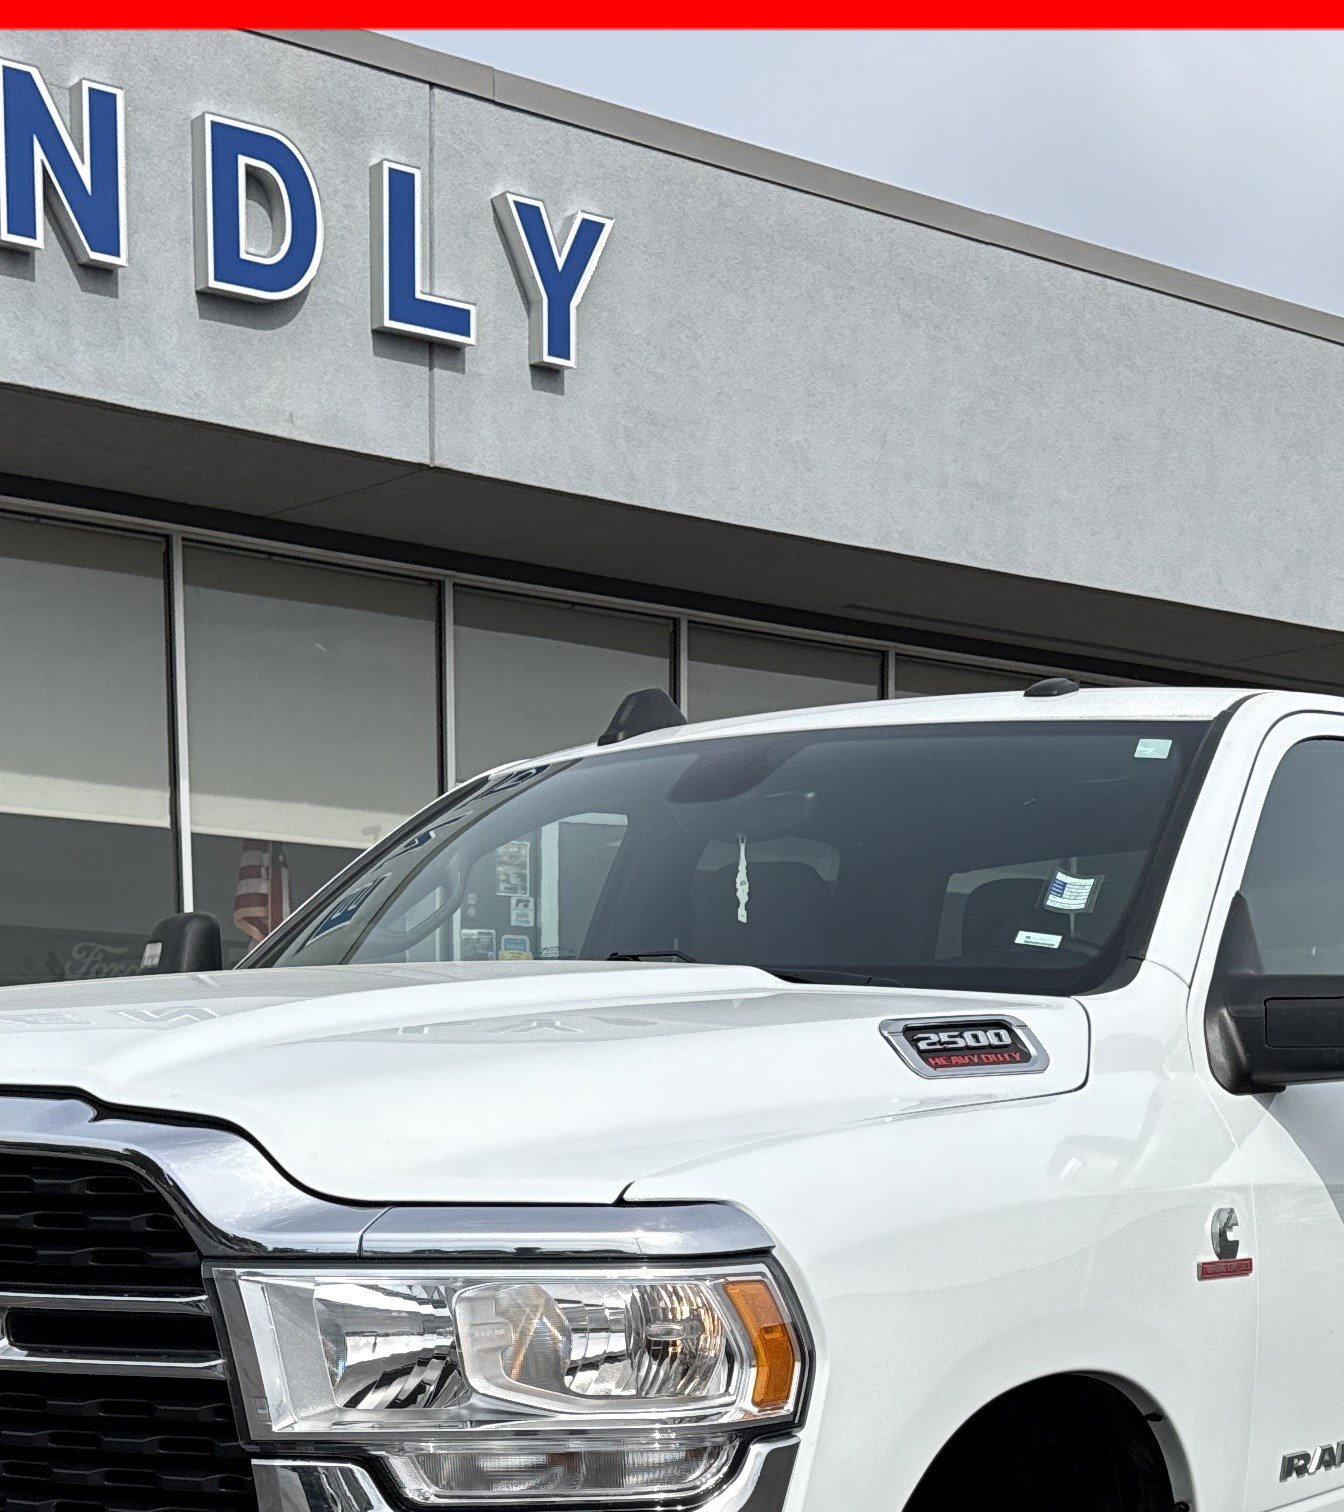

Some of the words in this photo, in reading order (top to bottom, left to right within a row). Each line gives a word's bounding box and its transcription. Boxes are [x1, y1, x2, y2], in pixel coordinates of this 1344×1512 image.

[912, 1029, 1013, 1051] 2500
[928, 1055, 979, 1067] HEAVY
[981, 1052, 1022, 1064] DUTY
